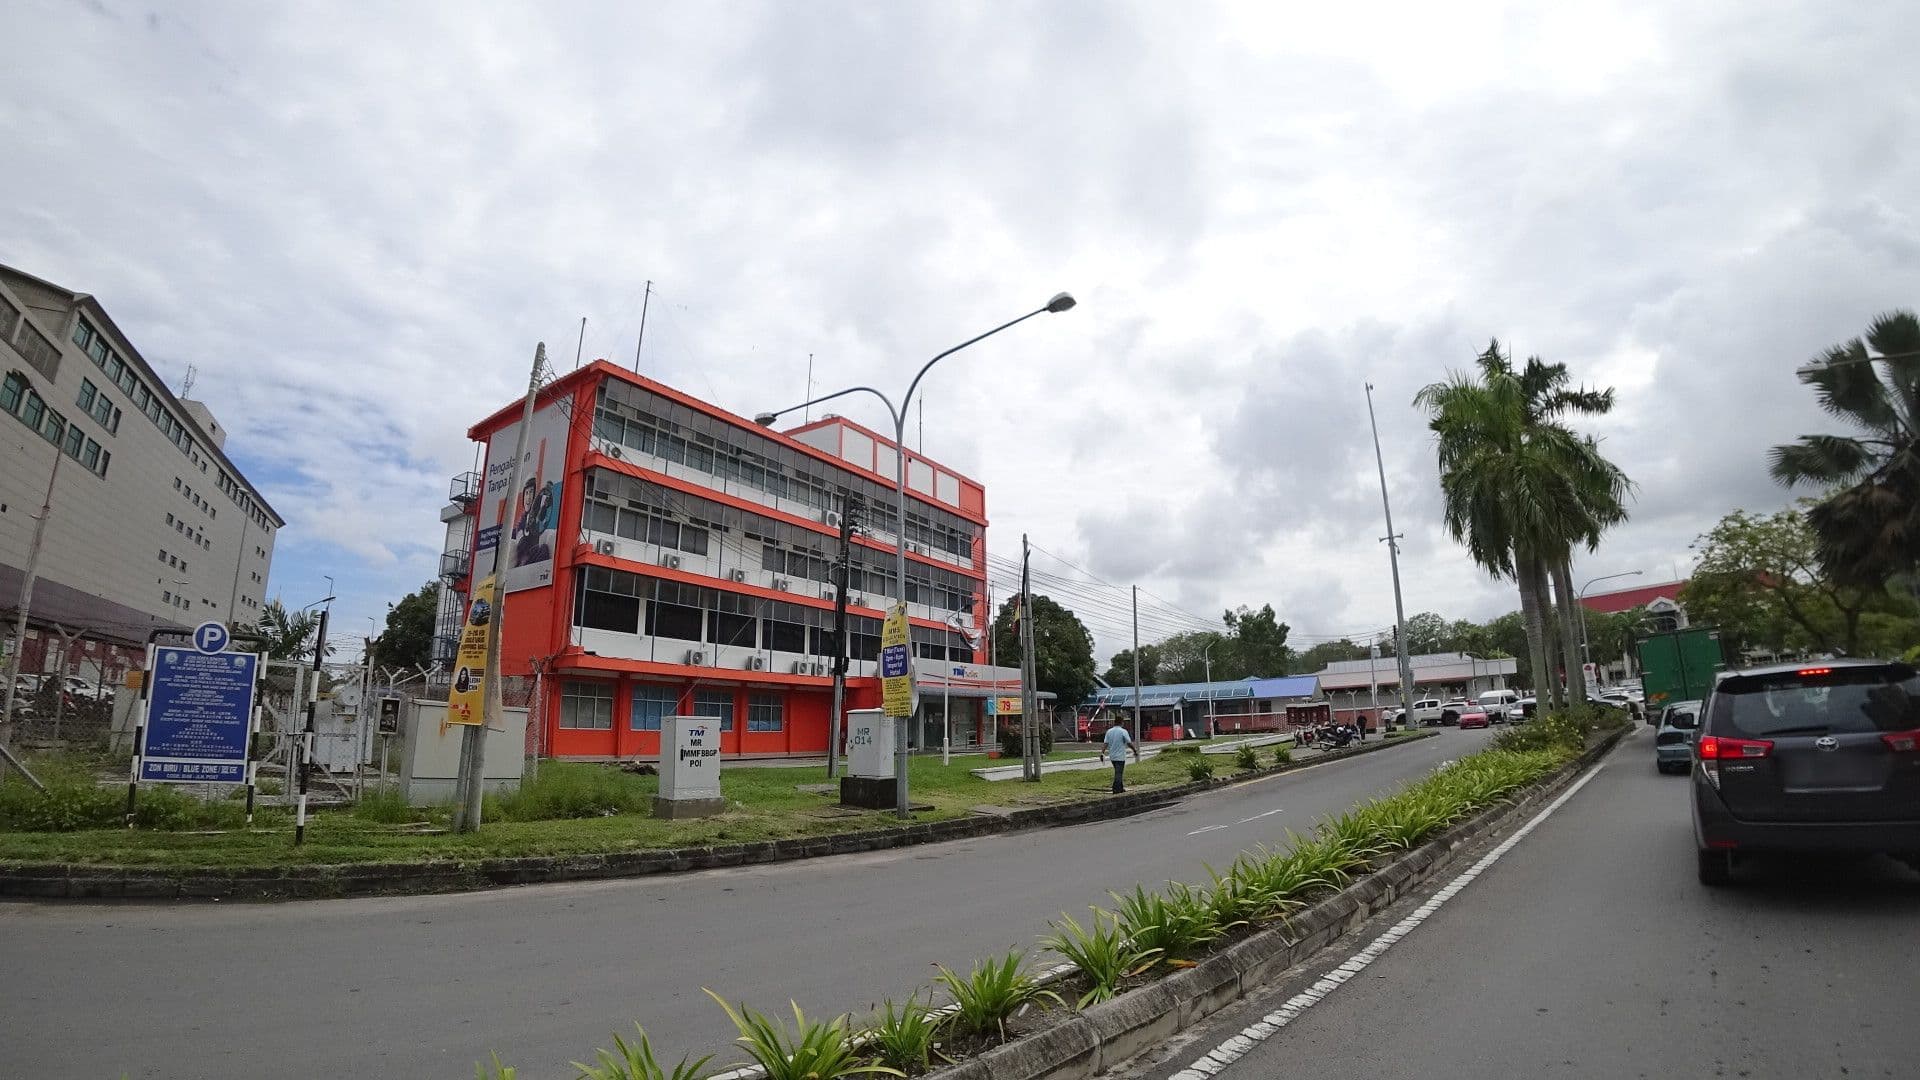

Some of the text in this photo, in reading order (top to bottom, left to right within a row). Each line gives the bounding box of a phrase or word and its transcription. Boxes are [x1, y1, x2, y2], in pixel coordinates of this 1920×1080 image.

[202, 627, 222, 648] P
[1002, 700, 1011, 710] 79
[857, 727, 870, 736] MR
[690, 739, 702, 747] MR
[183, 765, 200, 773] BLUE
[201, 765, 217, 774] ZONE
